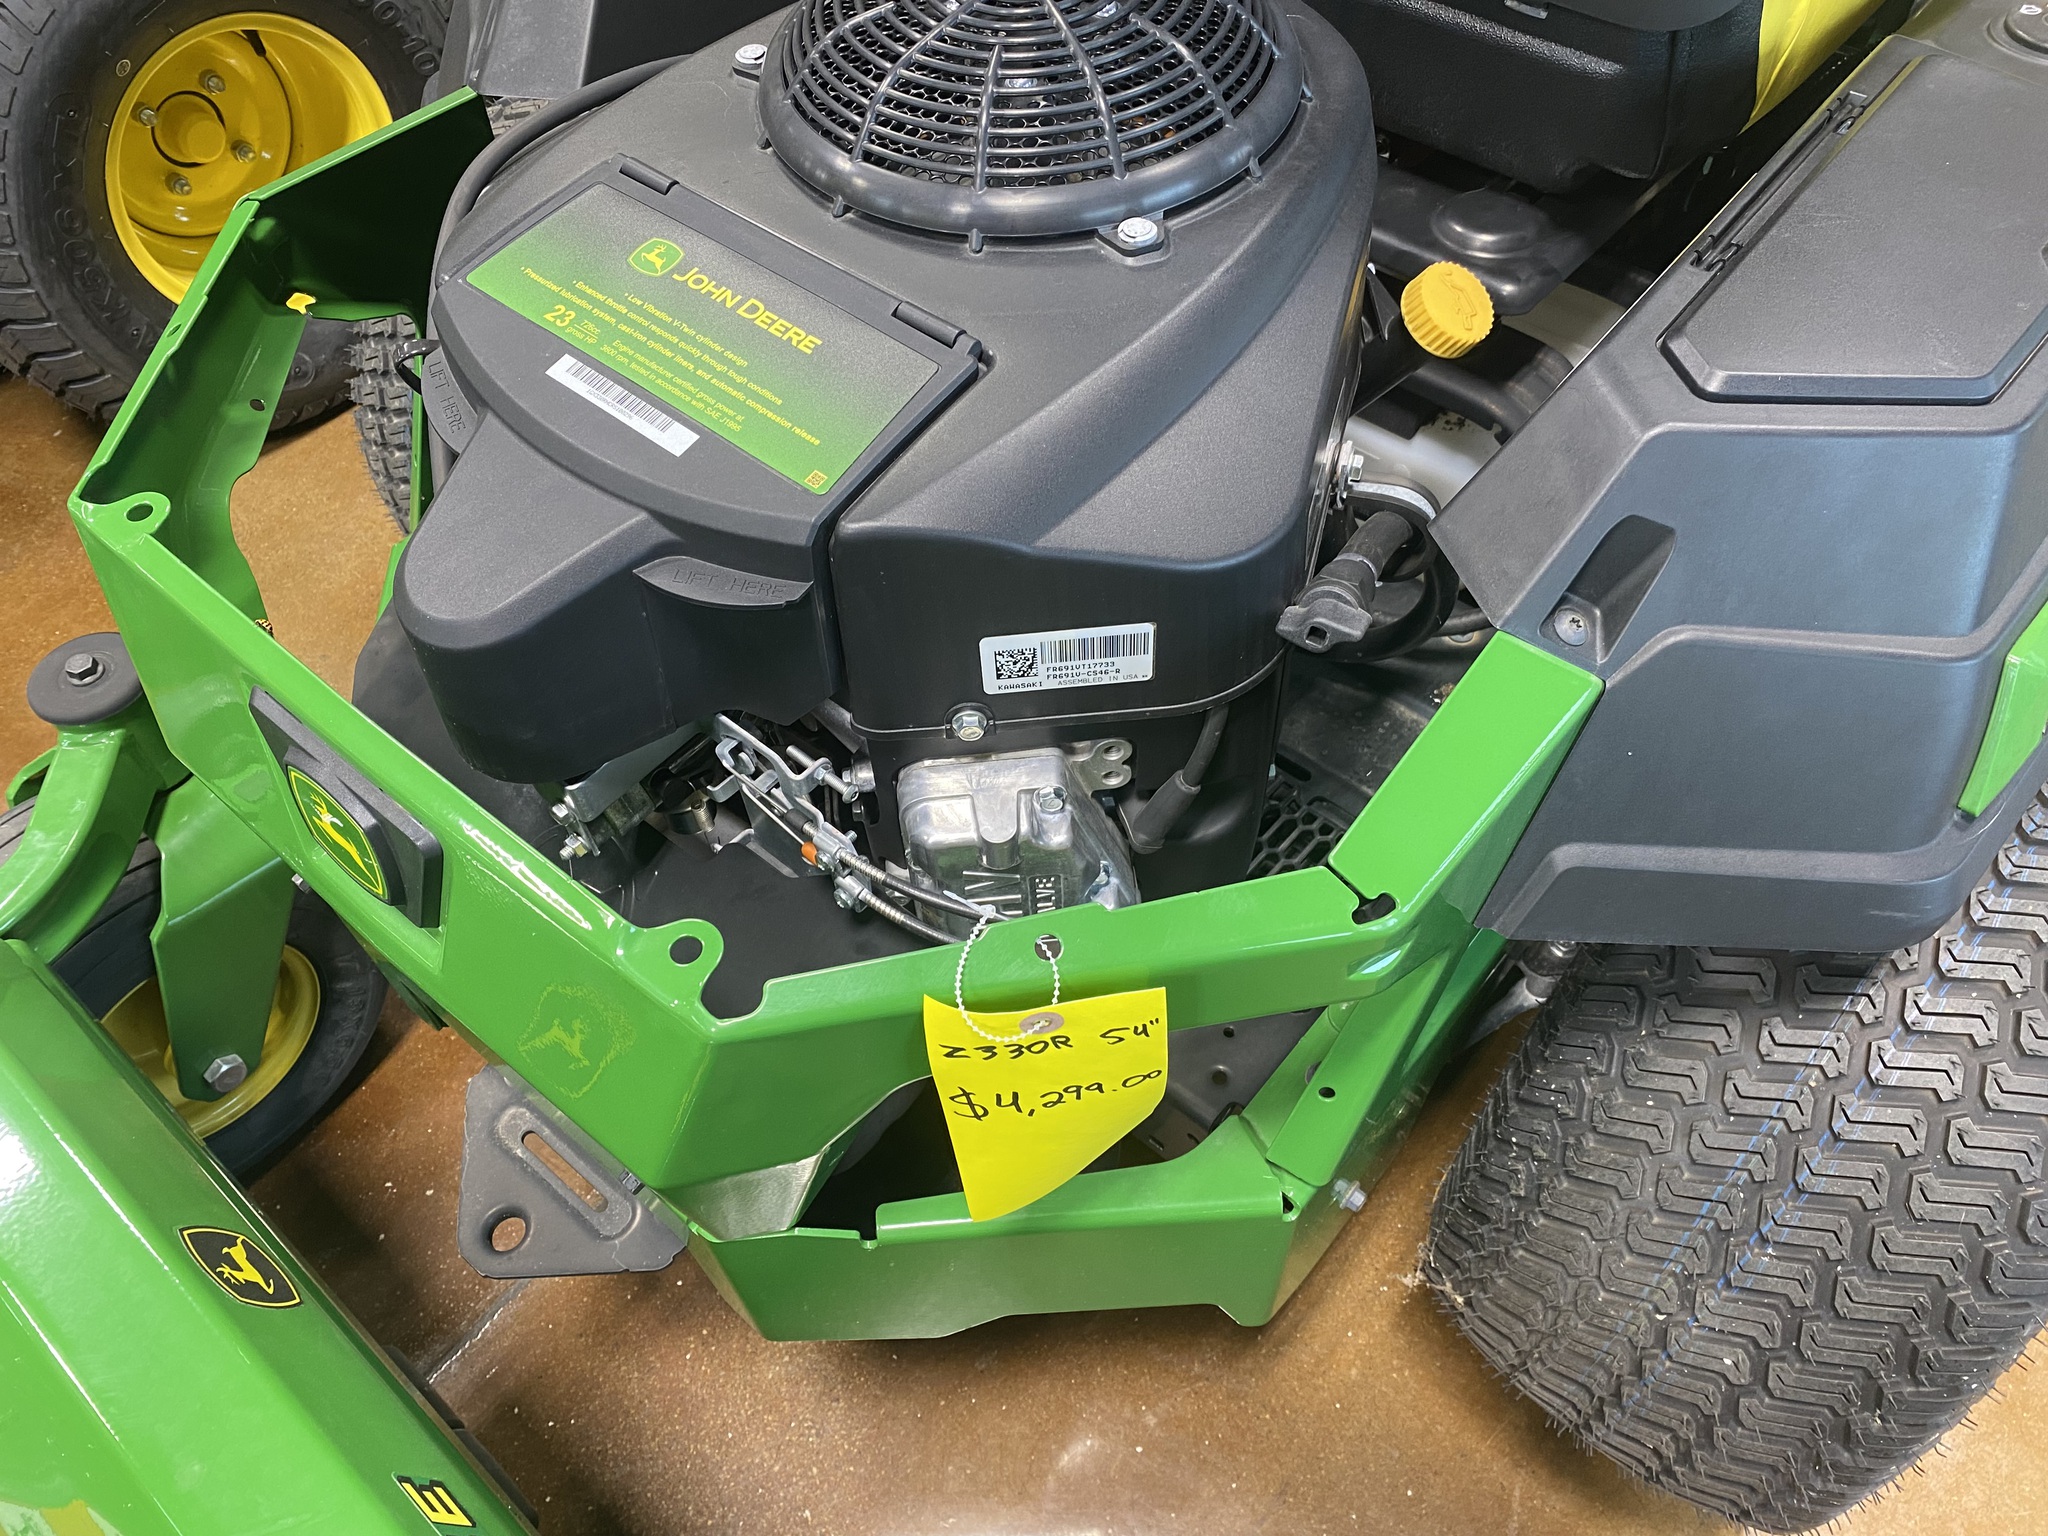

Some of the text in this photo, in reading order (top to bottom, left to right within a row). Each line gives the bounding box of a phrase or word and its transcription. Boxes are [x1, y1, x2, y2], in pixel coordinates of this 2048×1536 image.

[543, 304, 576, 327] 23
[565, 325, 598, 345] gross HP
[628, 293, 749, 368] Low Vibration V-Twin cylinder design
[672, 266, 823, 354] JOHN DEERE
[523, 267, 821, 447] Pressurized lubrication system, cast-iron cylinder liners, and automatic compression release
[575, 281, 783, 406] Enhanced throttle control responds quickly through tough conditions
[428, 361, 466, 434] LIFT HERE
[600, 345, 617, 358] 3600
[629, 361, 650, 377] tested
[649, 373, 656, 381] in
[654, 377, 691, 403] accordance
[690, 398, 705, 411] with
[703, 406, 721, 420] SAE
[718, 414, 742, 433] J1995
[612, 339, 745, 423] Engine manufacturer certified gross power at
[672, 569, 787, 598] LIFT HERE
[997, 681, 1043, 691] KAWASAKI
[1057, 676, 1103, 687] ASSEMBLED
[938, 1017, 1160, 1061] Z330R 54"
[949, 1069, 1163, 1121] $4,299.00
